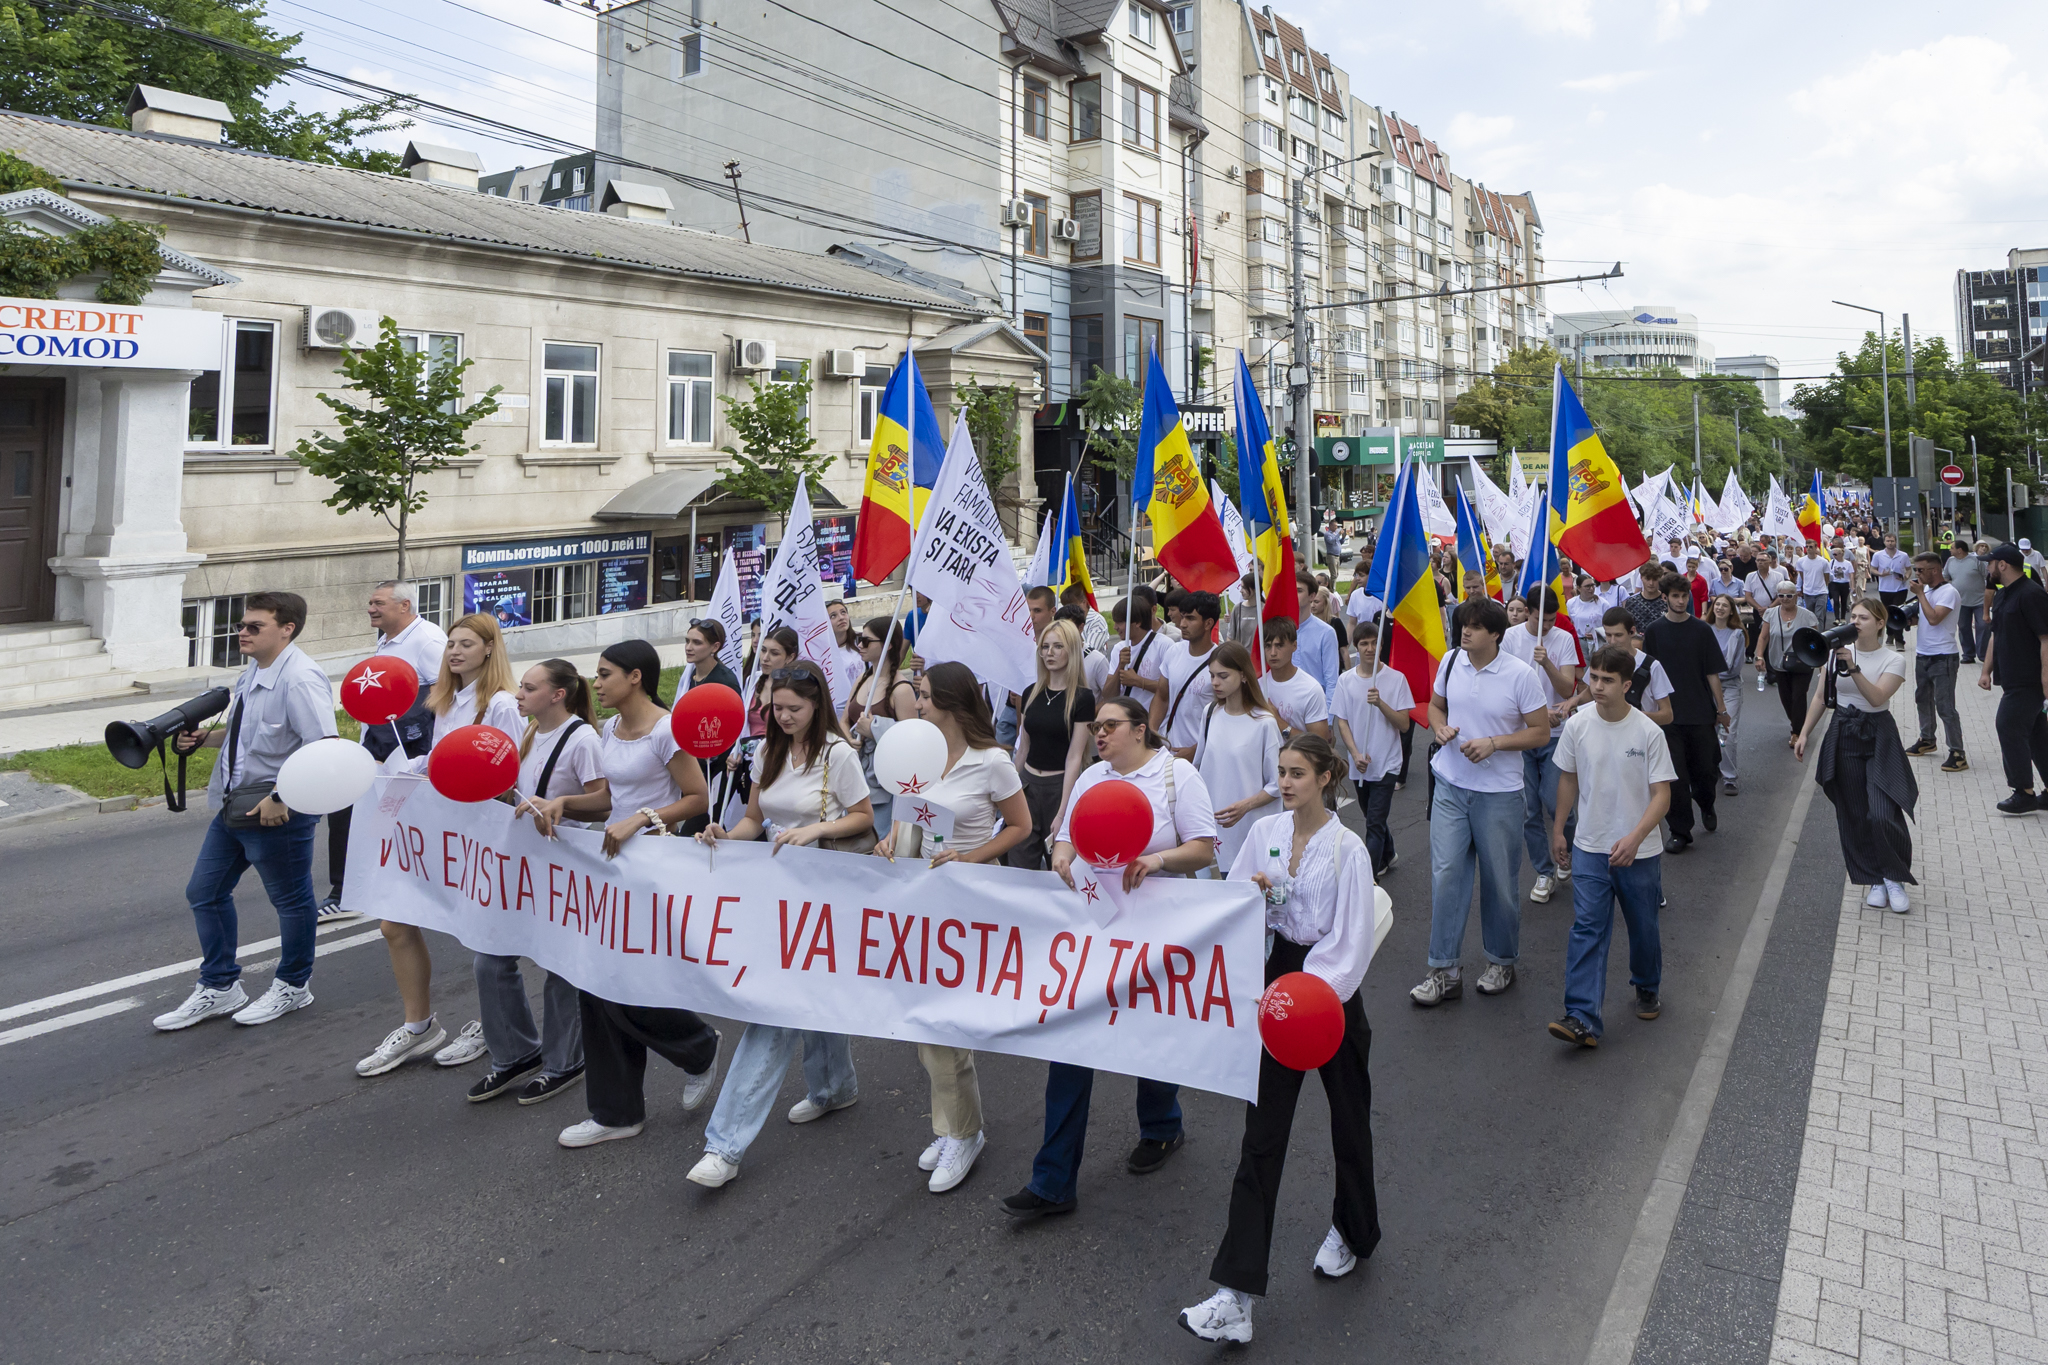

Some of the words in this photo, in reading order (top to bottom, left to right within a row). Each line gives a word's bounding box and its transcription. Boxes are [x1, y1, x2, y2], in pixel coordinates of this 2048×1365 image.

[0, 305, 143, 335] CREDIT
[0, 333, 139, 359] COMOD
[1179, 411, 1224, 432] OFFEE
[1221, 502, 1243, 528] УДЕТ
[467, 544, 562, 564] Компьютеры
[563, 543, 578, 556] от
[580, 540, 610, 555] 1000
[611, 536, 634, 552] лей
[636, 536, 648, 550] !!!
[934, 507, 957, 536] VA
[952, 520, 1000, 569] EXISTA
[923, 538, 946, 563] ȘI
[937, 547, 977, 585] ȚARA
[721, 596, 739, 628] VOR
[443, 831, 537, 916] EXISTA
[548, 862, 741, 988] FAMILIILE,
[779, 899, 837, 973] VA
[857, 907, 1024, 1000] EXISTA
[1037, 931, 1092, 1024] ȘI
[1106, 938, 1235, 1028] ȚARA
